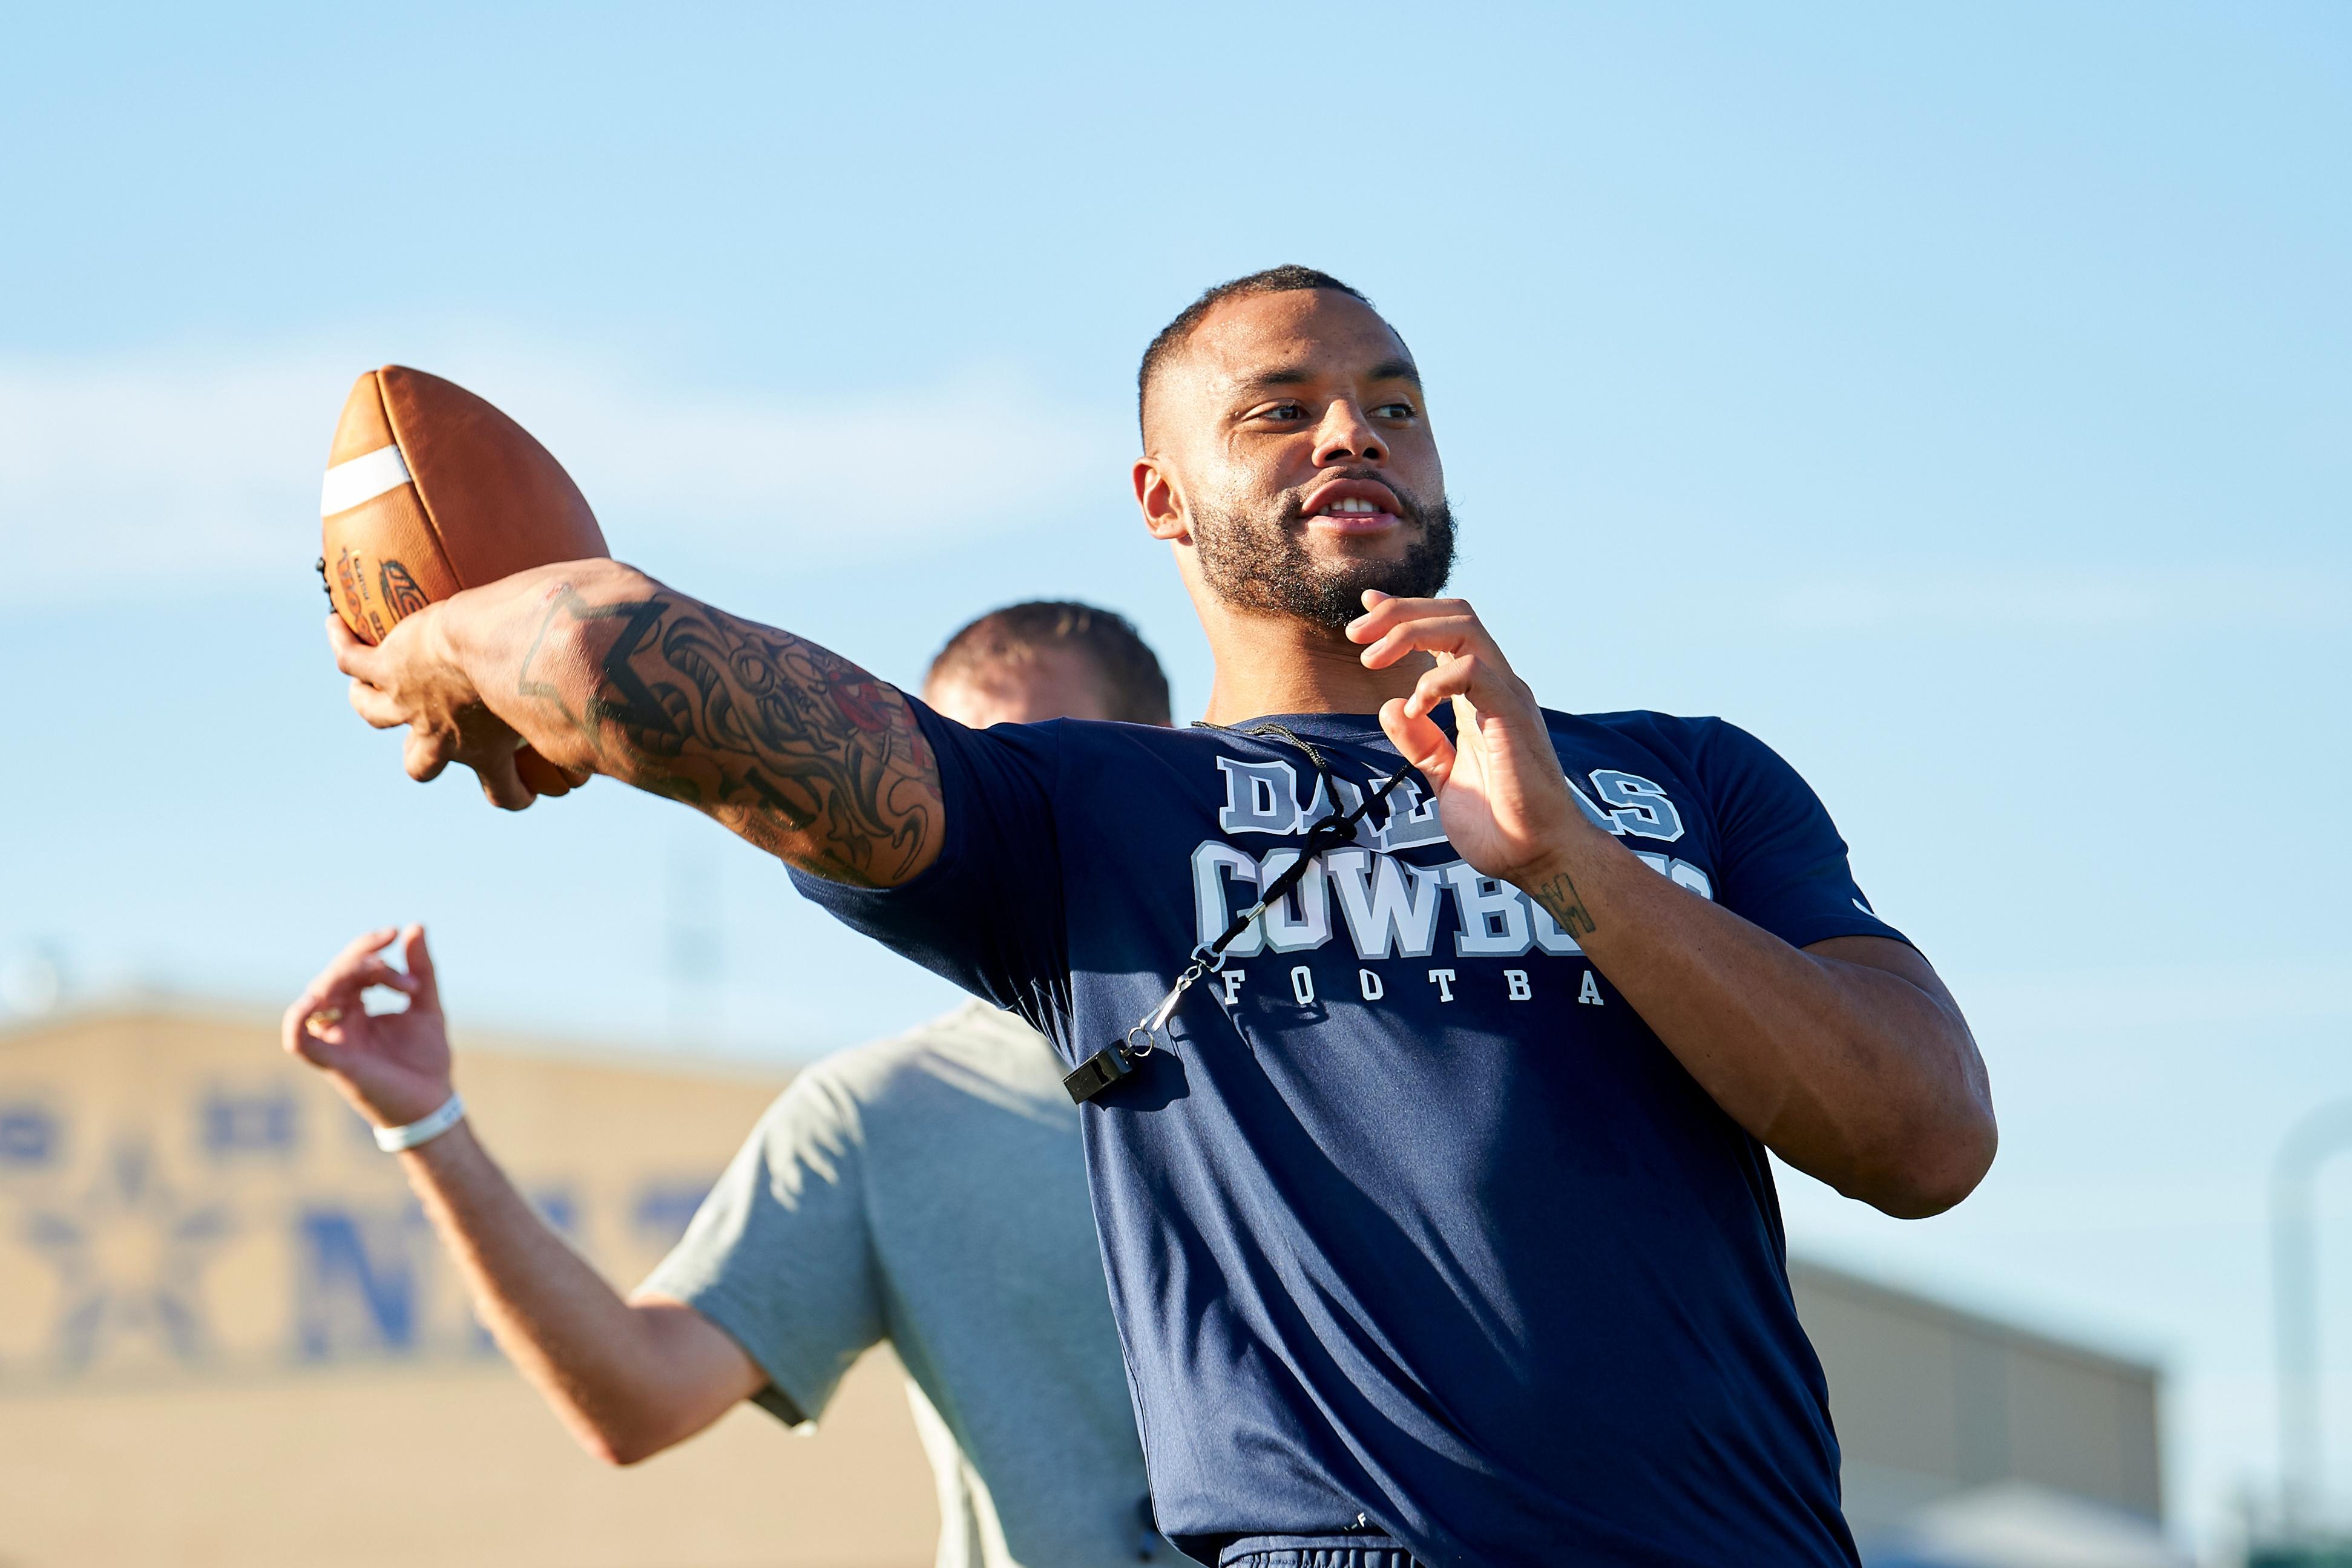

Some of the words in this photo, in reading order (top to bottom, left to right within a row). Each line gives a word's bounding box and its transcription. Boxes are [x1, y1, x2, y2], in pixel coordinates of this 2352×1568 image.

[1217, 756, 1684, 854] DALS
[1191, 839, 1713, 960] COWB
[1221, 966, 1604, 1005] FOOTBA
